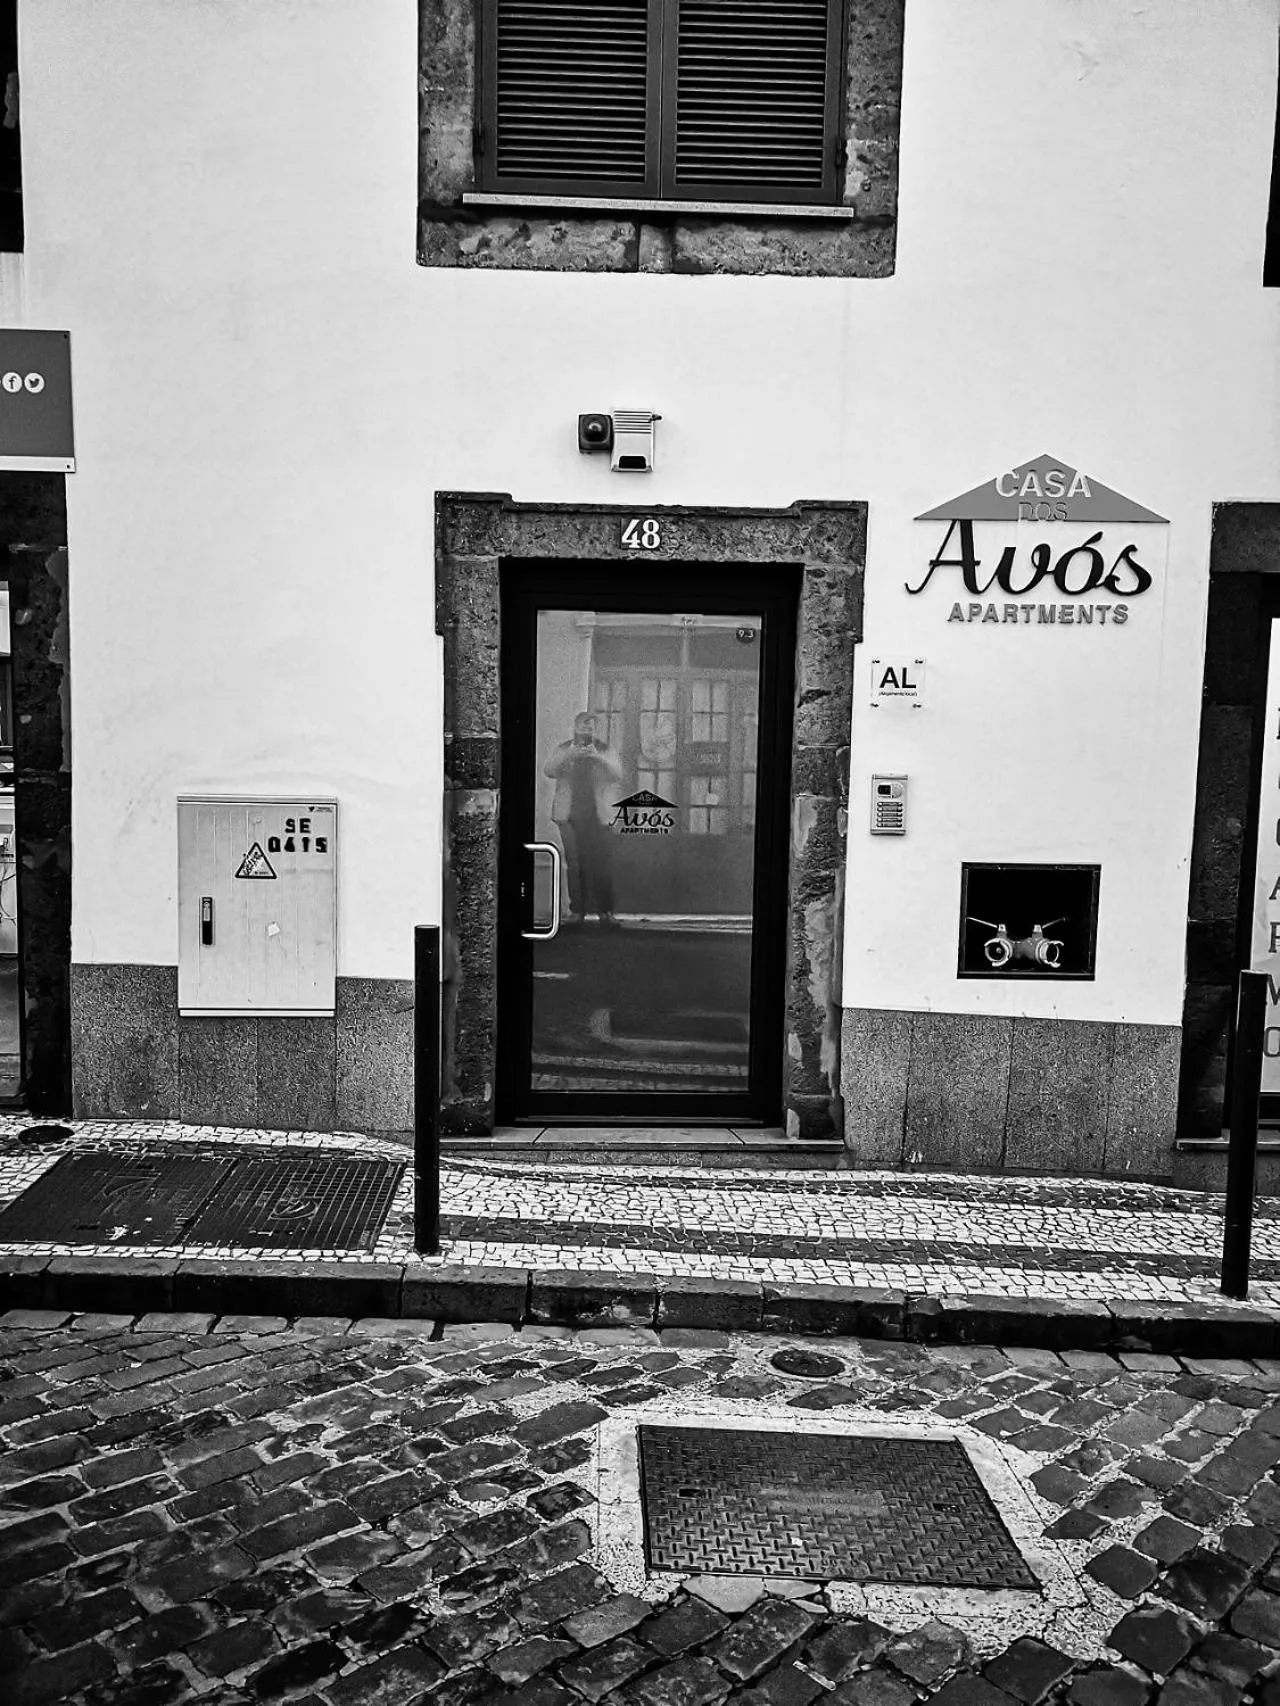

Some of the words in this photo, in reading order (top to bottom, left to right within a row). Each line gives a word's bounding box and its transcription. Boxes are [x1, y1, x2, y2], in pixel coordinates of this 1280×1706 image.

[996, 469, 1092, 498] CASA
[1017, 501, 1068, 522] DOS
[621, 519, 660, 549] 48
[904, 519, 1152, 596] Avós
[947, 602, 1130, 625] APARTMENTS
[879, 666, 917, 689] AL
[284, 817, 311, 834] SE
[608, 806, 675, 827] Avós
